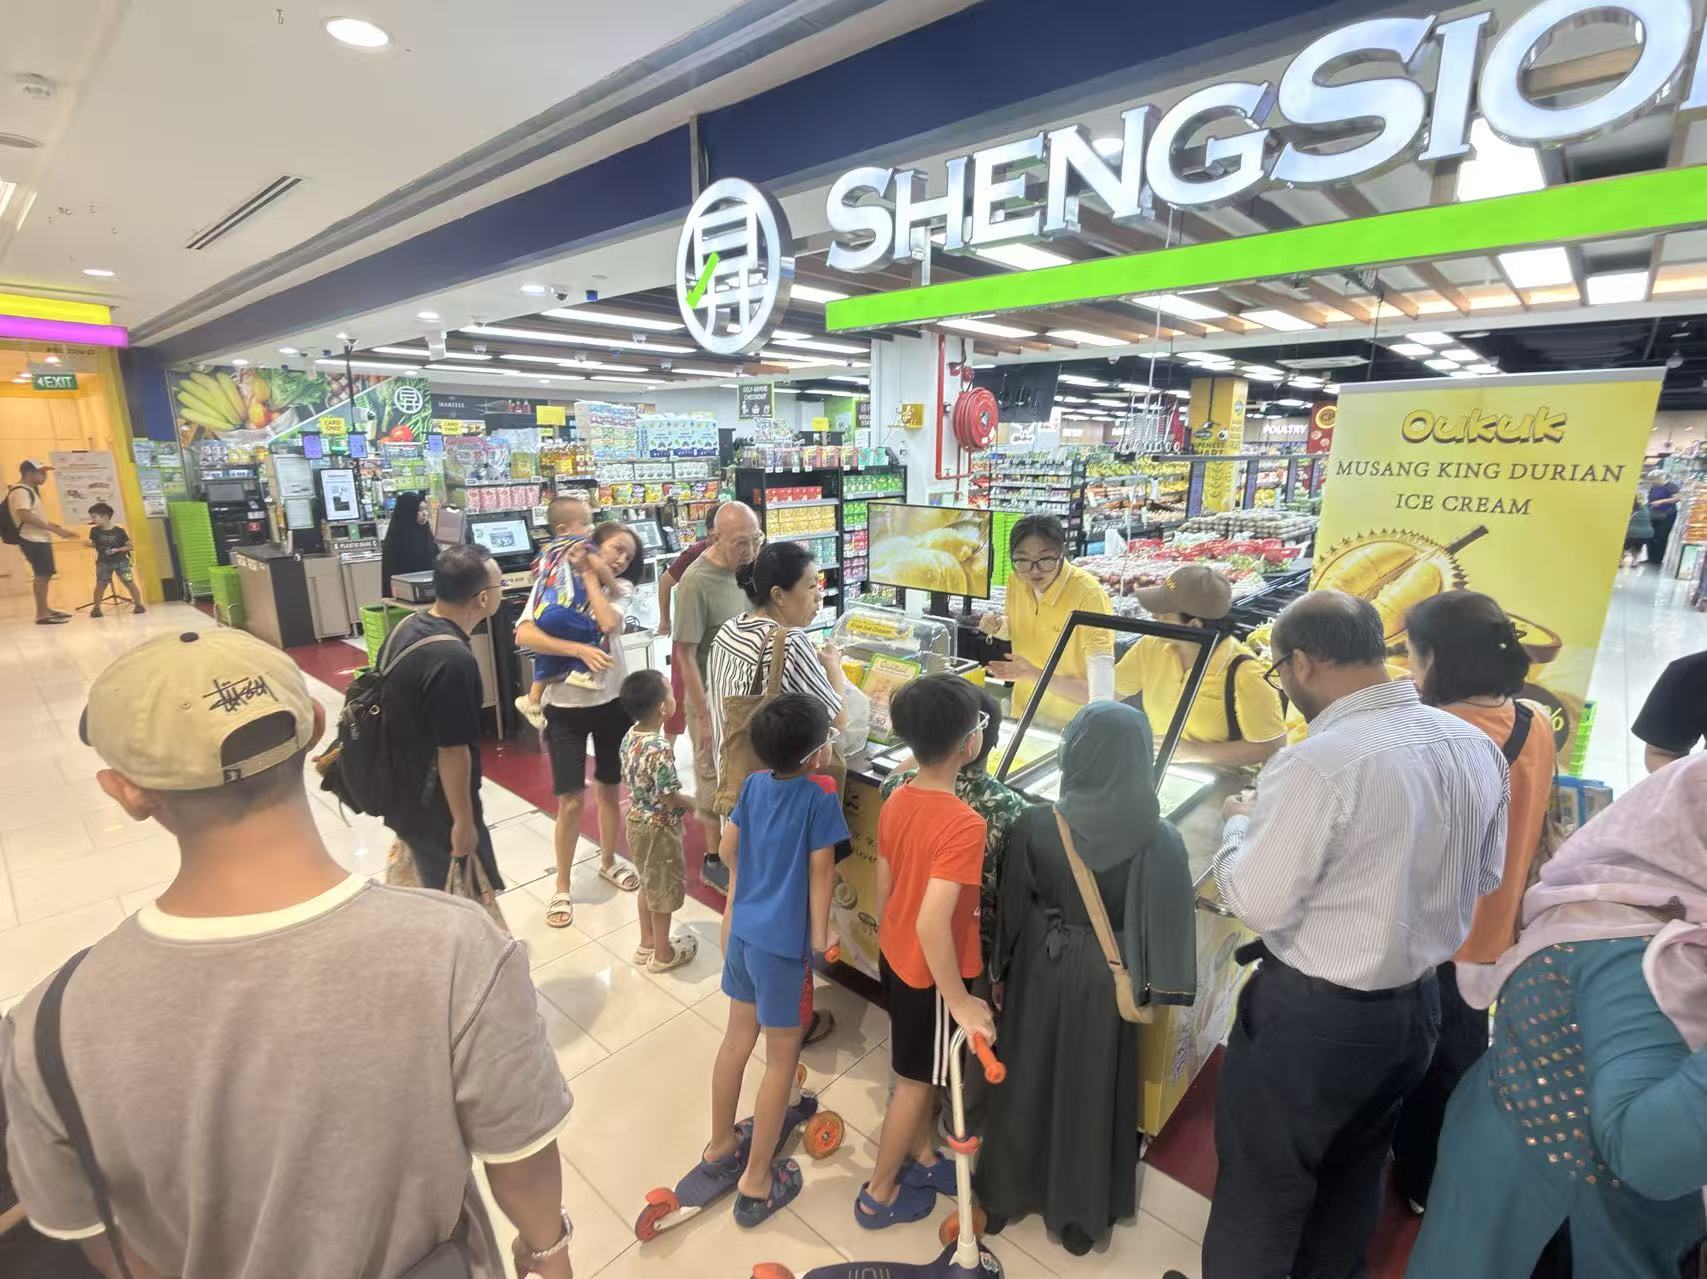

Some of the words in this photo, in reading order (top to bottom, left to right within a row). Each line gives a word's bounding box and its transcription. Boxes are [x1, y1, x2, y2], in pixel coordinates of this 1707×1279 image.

[45, 376, 73, 388] EXIT
[1263, 424, 1307, 435] POULTRY
[1401, 406, 1568, 444] Oukuk
[1336, 460, 1430, 478] MUSANG
[1436, 462, 1501, 480] KING
[1508, 464, 1627, 484] DURIAN
[1395, 493, 1434, 510] ICE
[1442, 495, 1533, 515] CREAM
